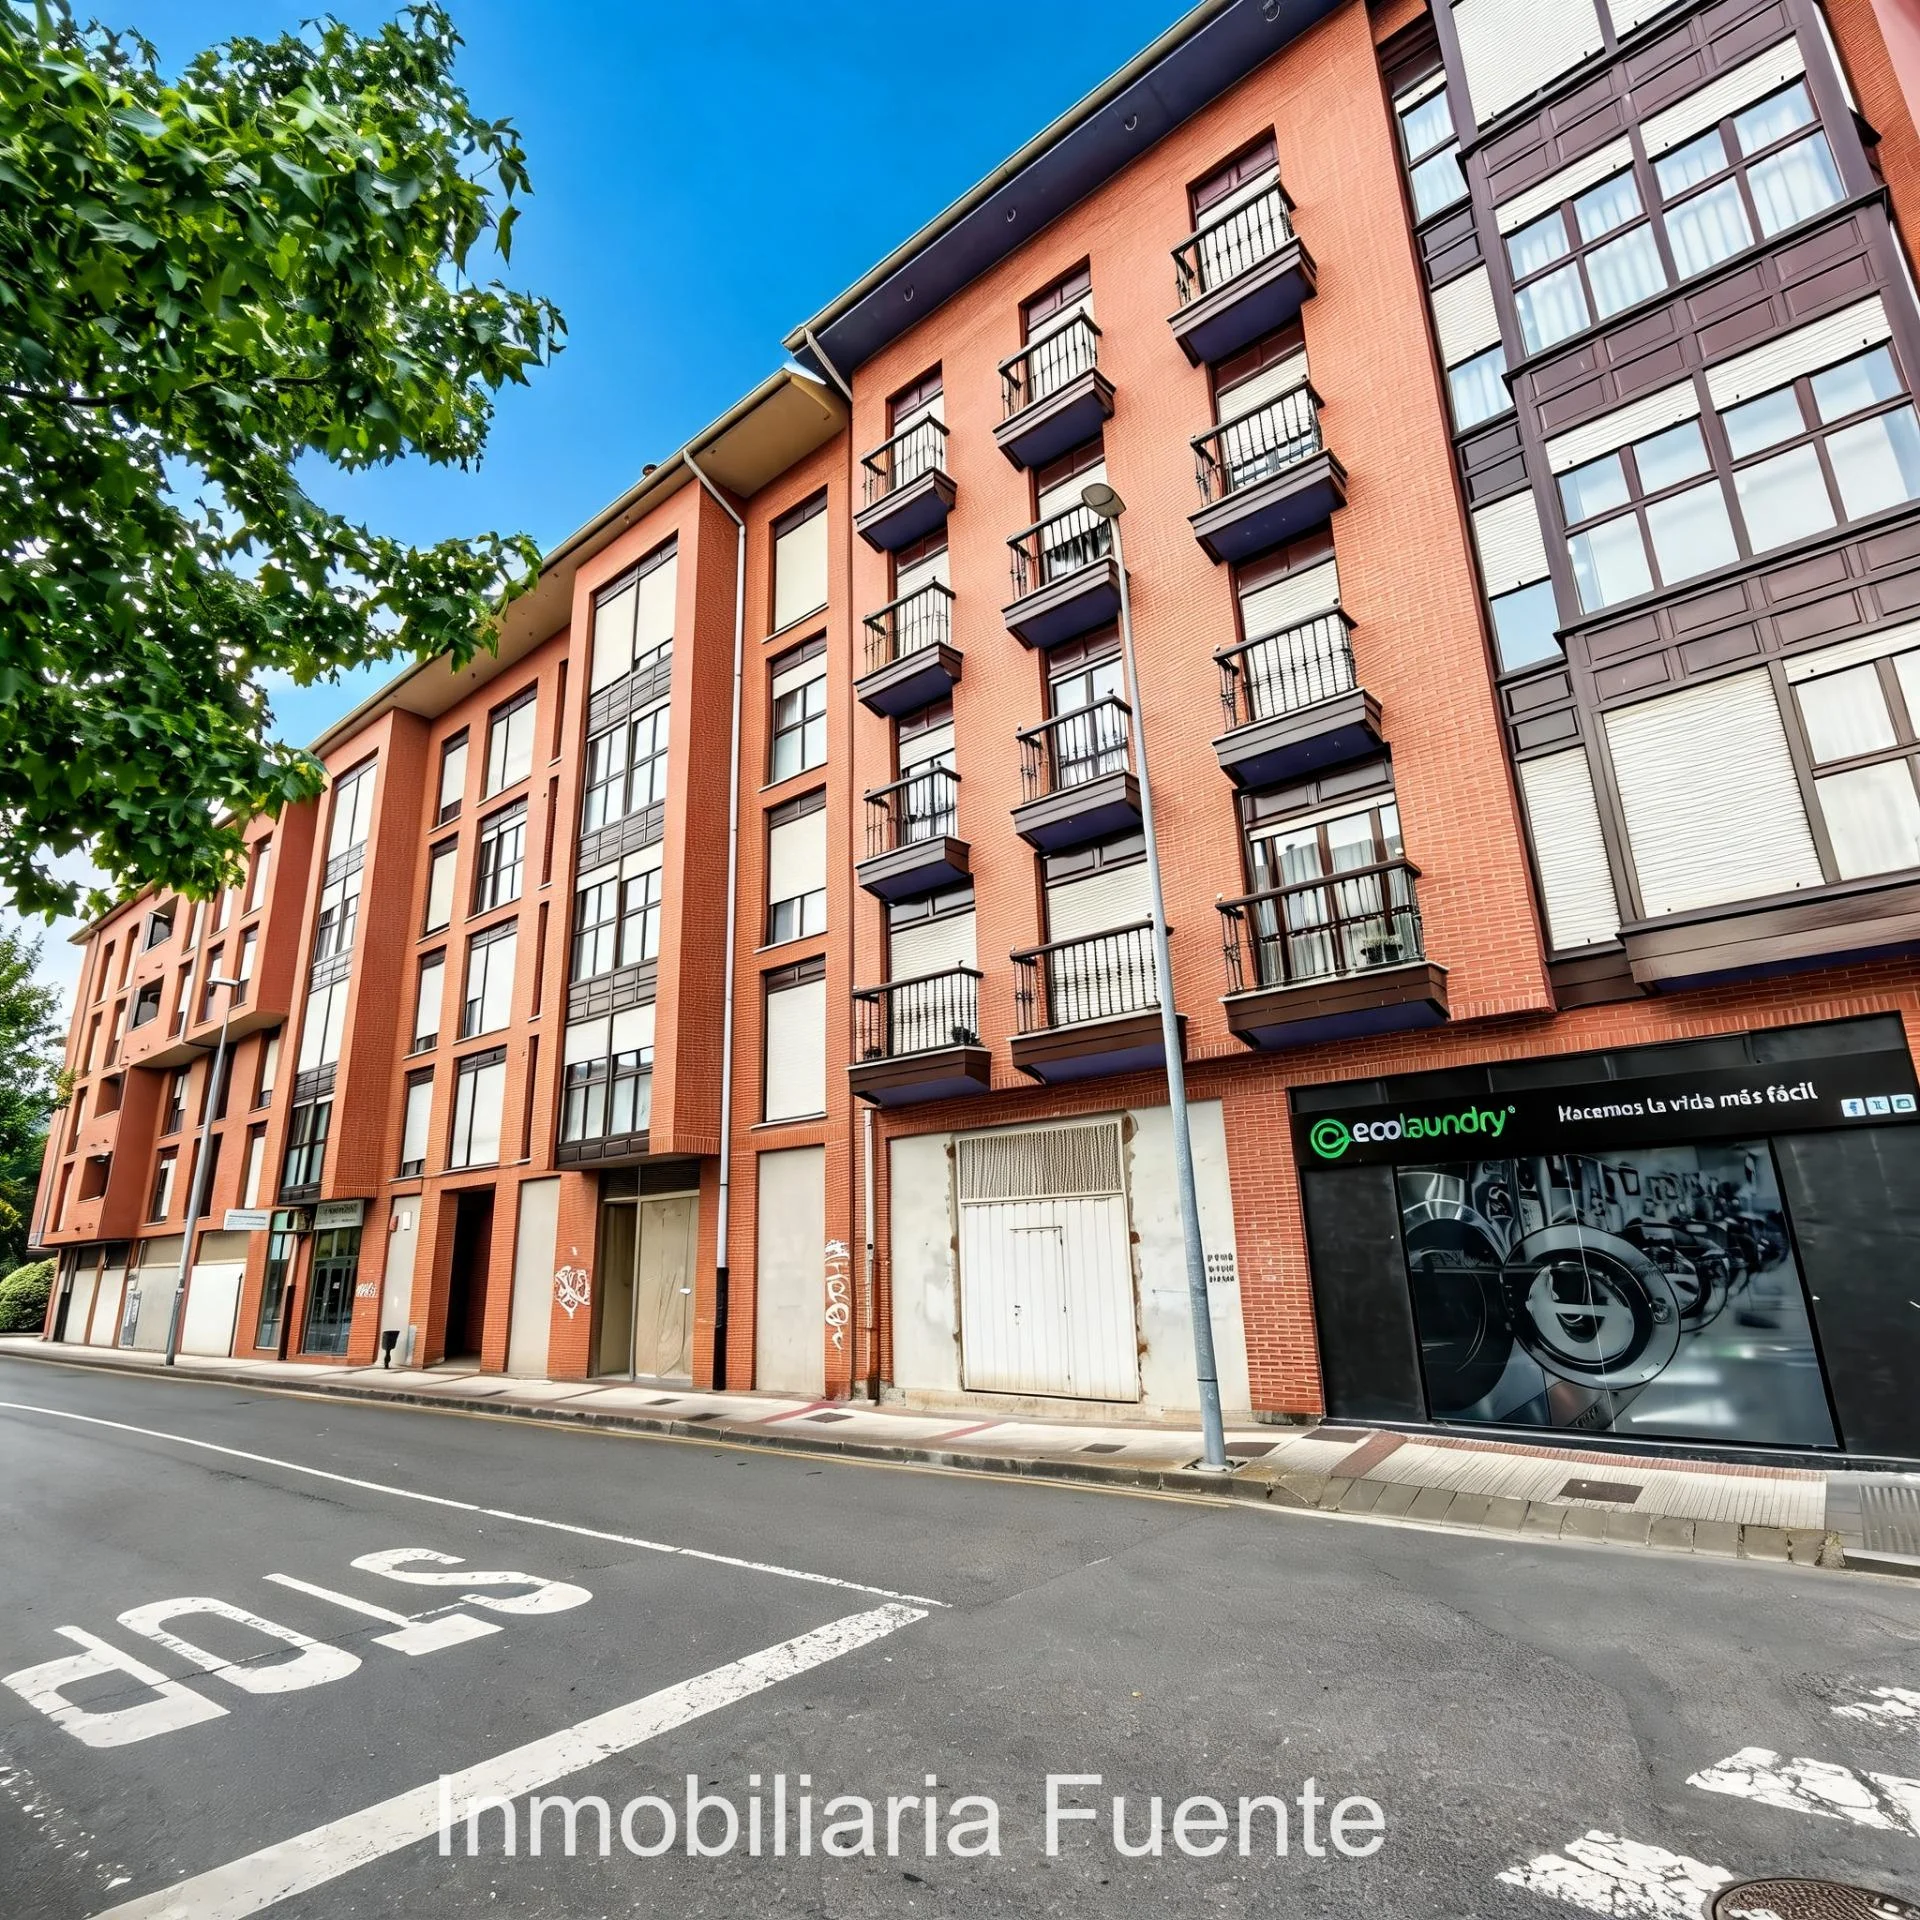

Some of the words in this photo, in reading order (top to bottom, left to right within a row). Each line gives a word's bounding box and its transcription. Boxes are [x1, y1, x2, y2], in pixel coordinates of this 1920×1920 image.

[1670, 1093, 1715, 1111] vida
[1720, 1089, 1763, 1107] más
[1767, 1081, 1818, 1104] fácil
[0, 1547, 593, 1748] STOP
